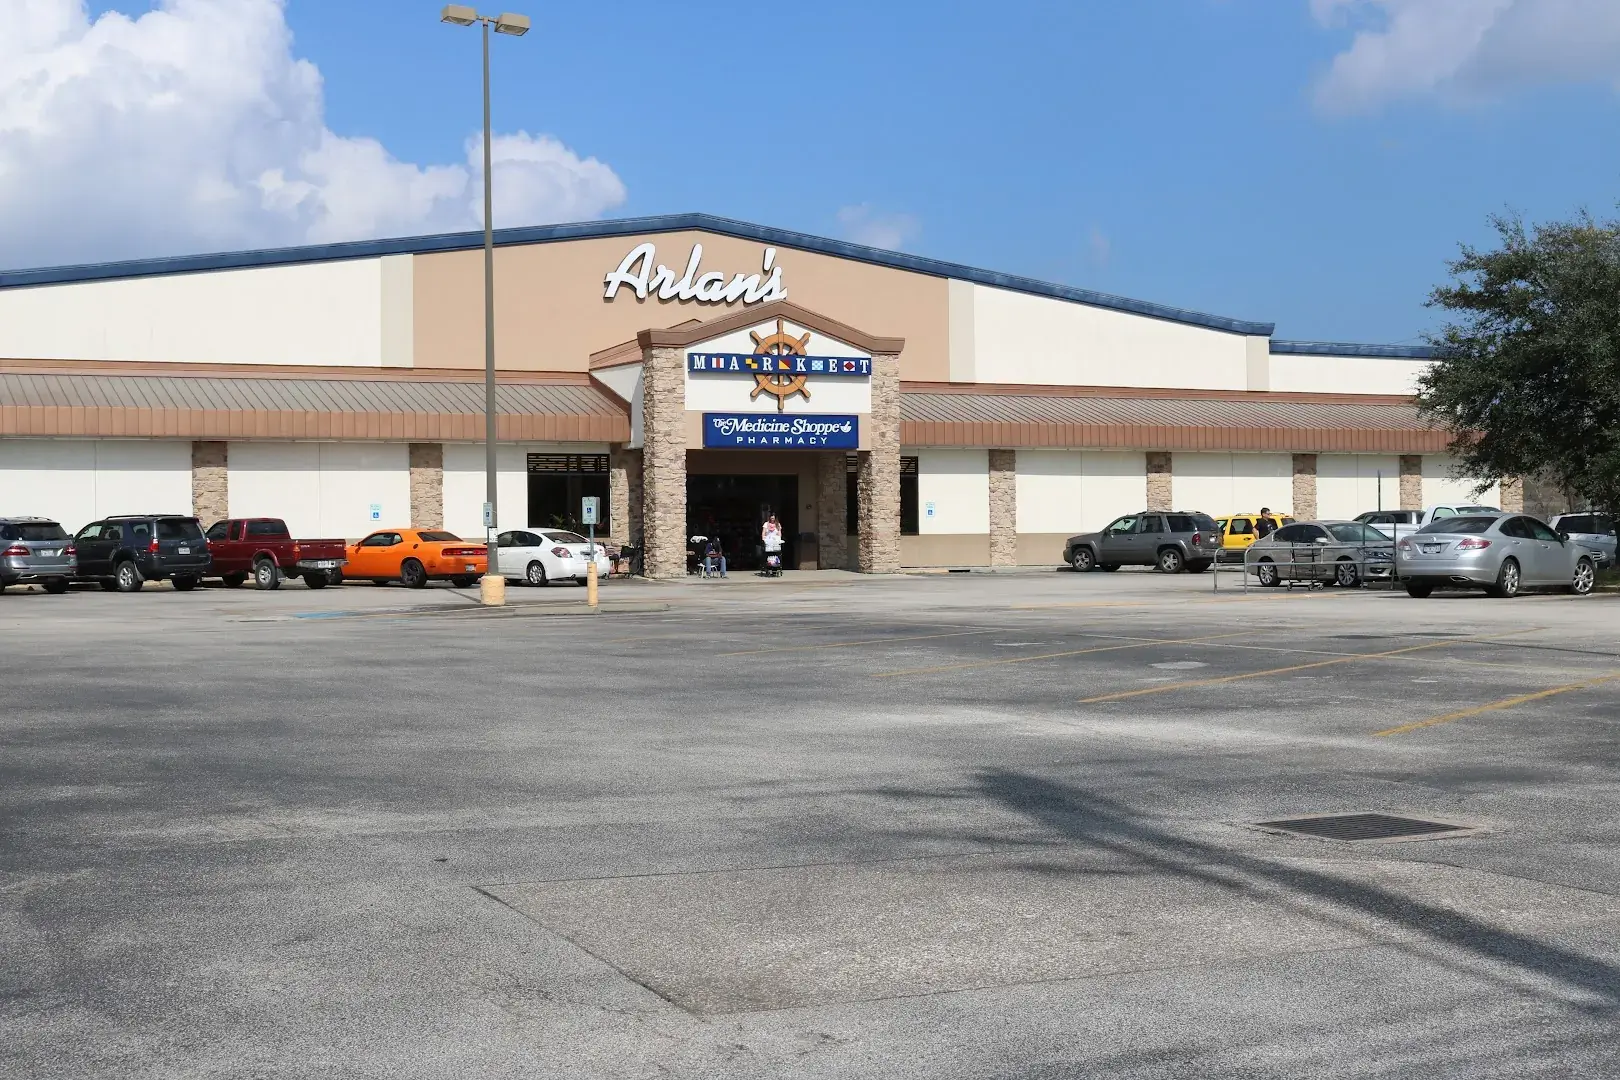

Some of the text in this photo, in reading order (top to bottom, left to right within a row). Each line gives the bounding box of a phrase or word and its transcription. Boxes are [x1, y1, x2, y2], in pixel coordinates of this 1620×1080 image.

[603, 242, 788, 304] Arlan's
[693, 355, 869, 373] MARKET
[713, 418, 840, 436] The Medicine Shoppe
[736, 436, 828, 445] PHARMACY
